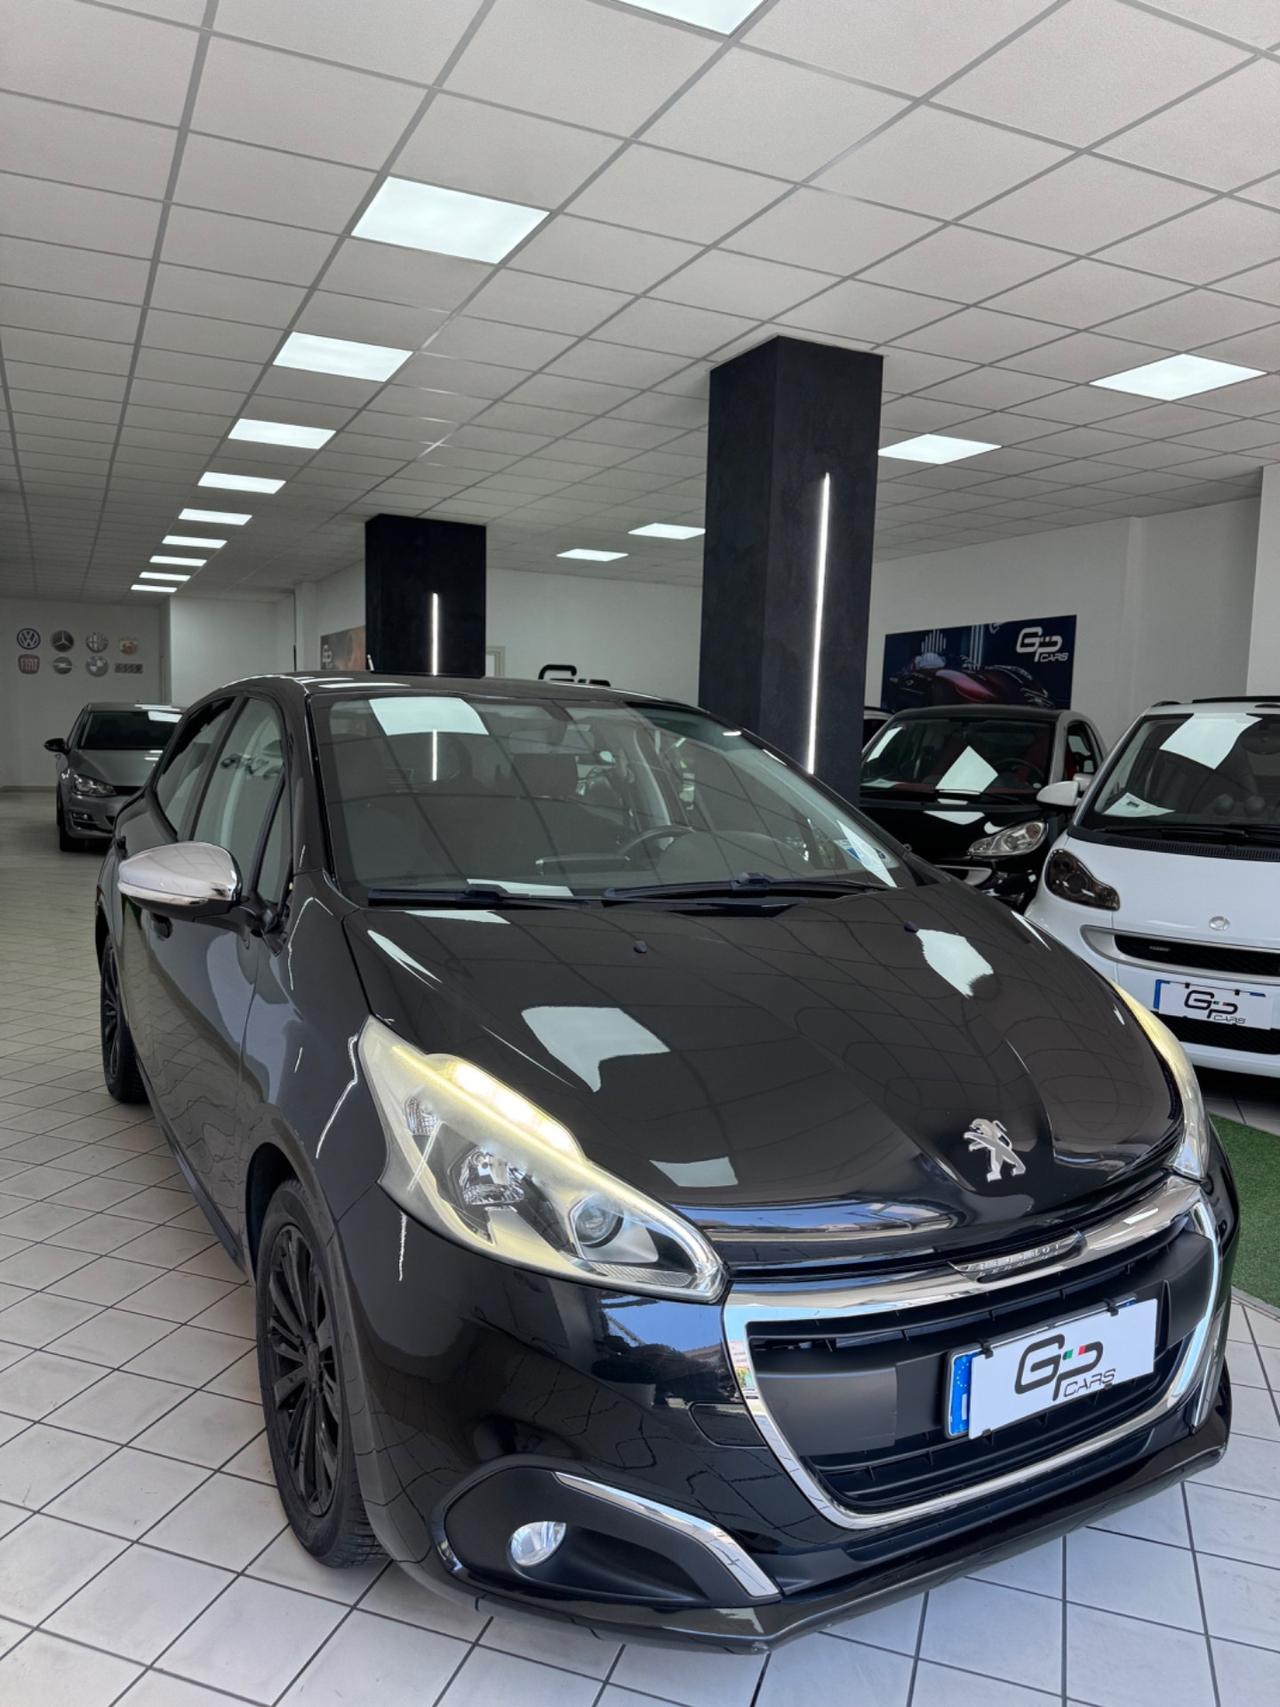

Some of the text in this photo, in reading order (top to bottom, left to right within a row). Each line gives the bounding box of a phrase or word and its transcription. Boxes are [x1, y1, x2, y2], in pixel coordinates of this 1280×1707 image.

[1016, 626, 1063, 662] GP
[1040, 652, 1069, 662] CARS
[1184, 990, 1238, 1019] GP
[1213, 1014, 1246, 1025] CARS
[1014, 1333, 1104, 1402] GP
[1063, 1367, 1116, 1398] CARS
